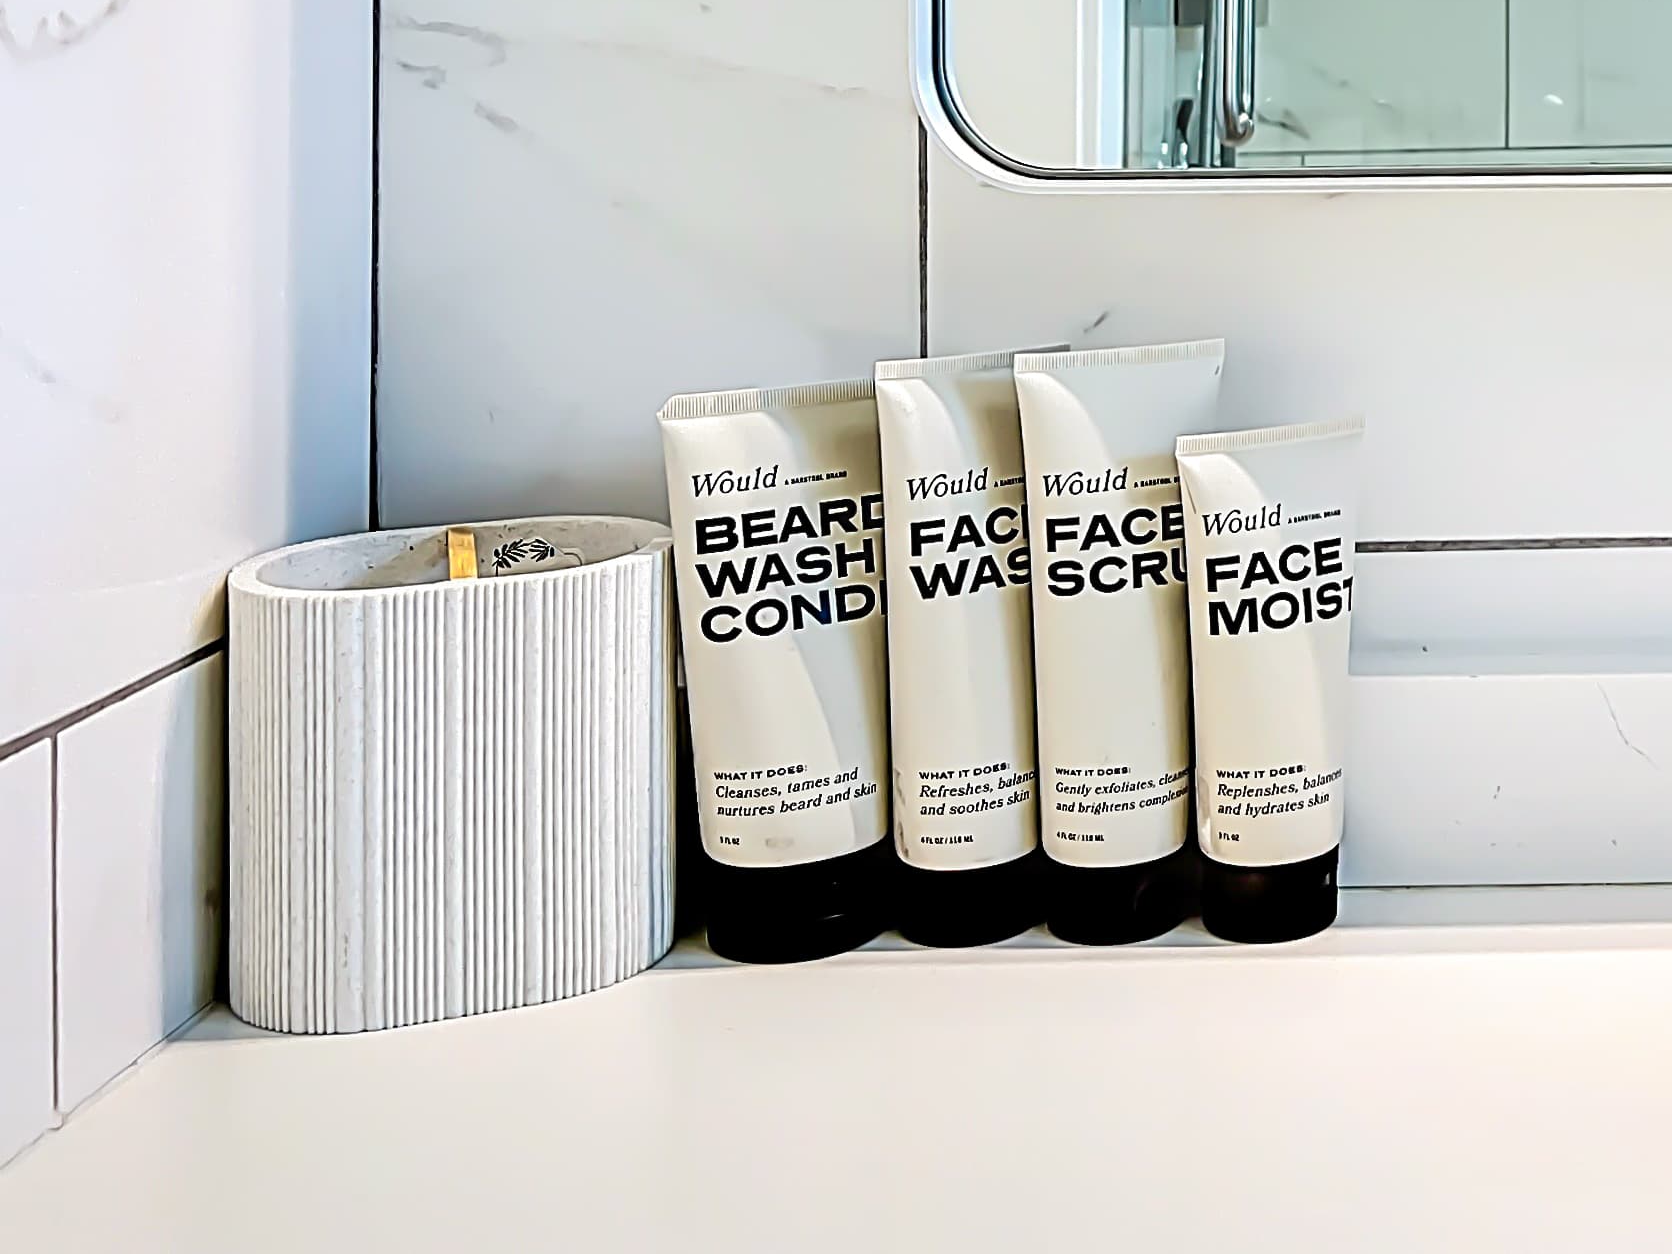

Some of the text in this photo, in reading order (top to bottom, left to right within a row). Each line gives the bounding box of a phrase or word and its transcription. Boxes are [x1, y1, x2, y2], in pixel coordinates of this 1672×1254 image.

[691, 464, 779, 497] Would
[906, 467, 988, 500] Would
[1043, 466, 1128, 497] Would
[696, 493, 885, 555] BEARD
[1046, 503, 1184, 552] FACE
[1202, 503, 1281, 536] Would
[695, 538, 875, 598] WASH
[1206, 537, 1343, 592] FACE
[714, 764, 808, 780] WHAT IT DOES:
[716, 767, 859, 799] Cleanses, tames and
[919, 762, 1010, 780] WHAT IT DOES:
[1055, 768, 1082, 776] WHAT
[1216, 770, 1250, 779] WHAT
[1254, 770, 1265, 778] IT
[717, 782, 877, 816] nurtures beard and skin
[920, 783, 993, 797] Refreshes,
[920, 789, 1030, 815] and soothes skin
[1056, 782, 1092, 797] Gently
[1095, 779, 1155, 794] exfoliates,
[1056, 802, 1075, 813] and
[1078, 801, 1136, 815] brightens
[1218, 792, 1330, 818] and hydrates skin
